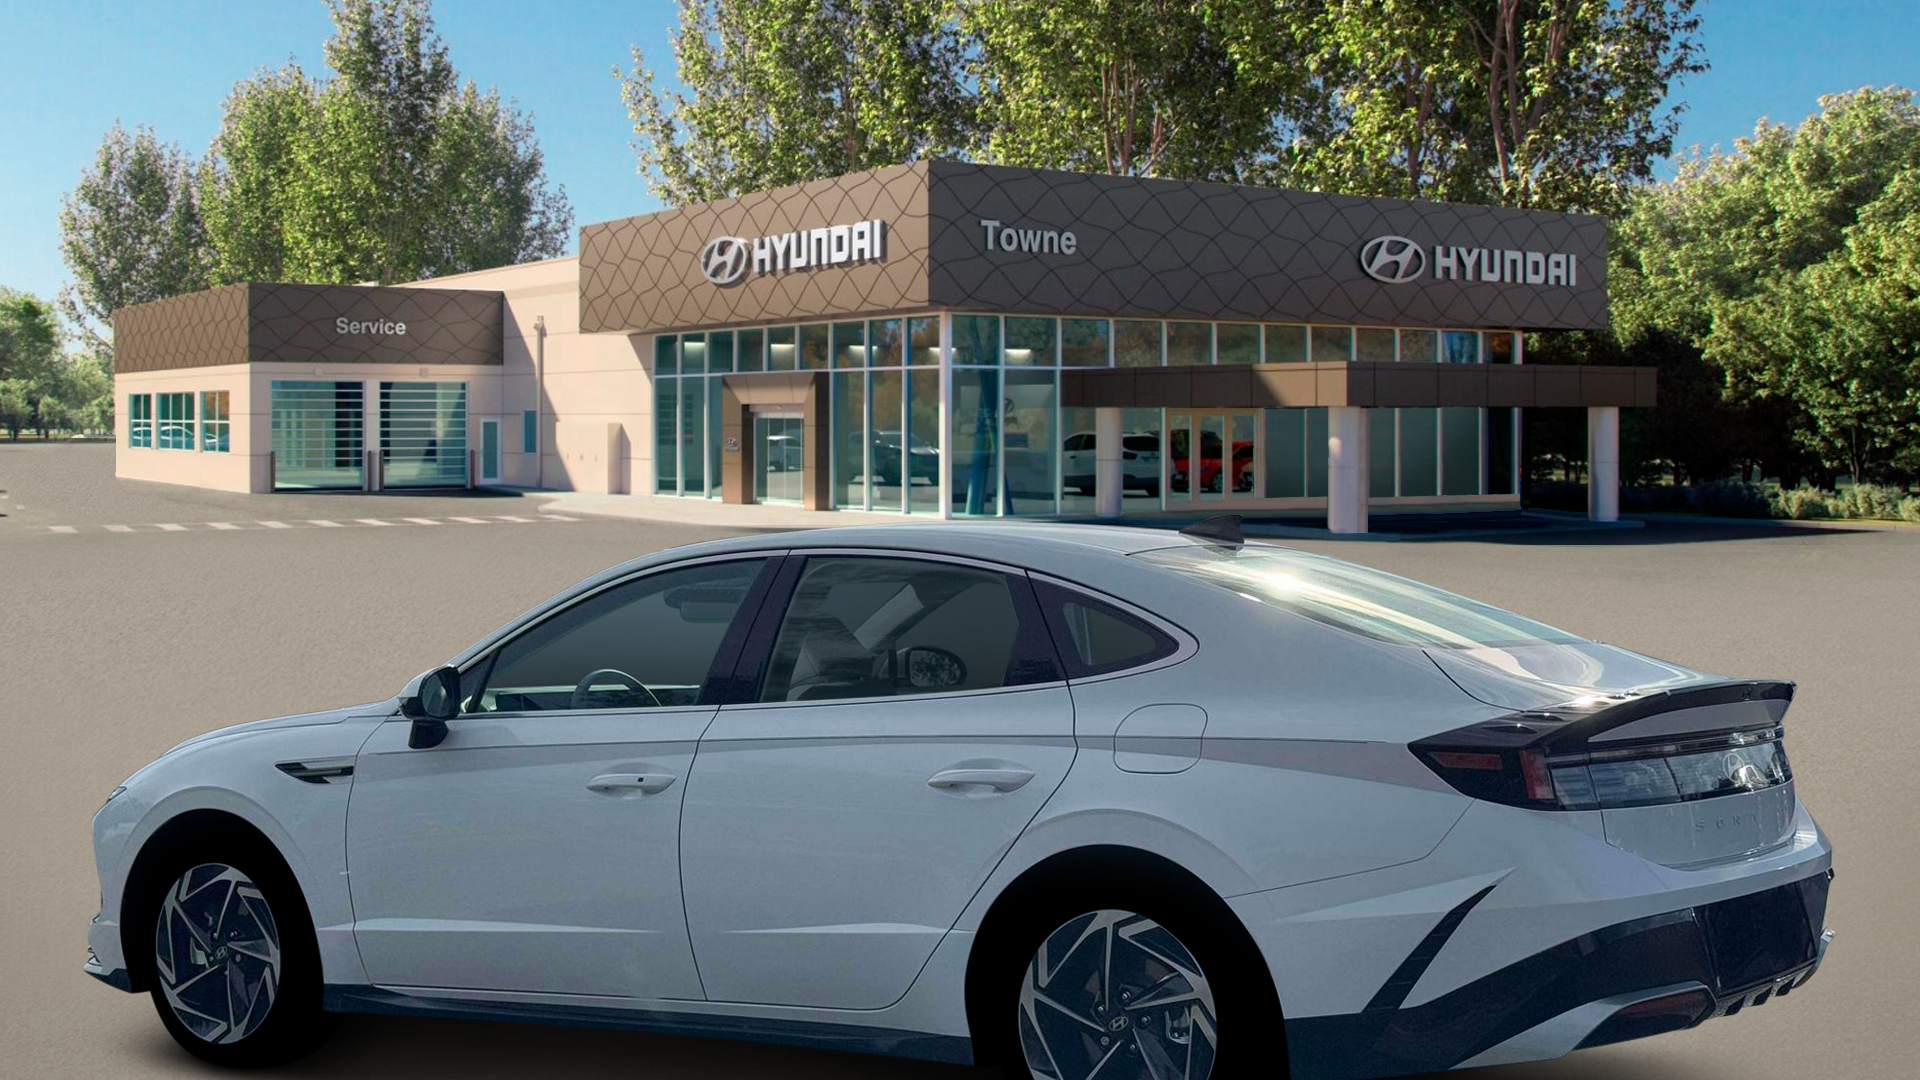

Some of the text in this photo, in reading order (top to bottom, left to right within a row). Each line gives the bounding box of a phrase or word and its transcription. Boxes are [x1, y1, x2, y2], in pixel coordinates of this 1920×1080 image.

[753, 219, 881, 273] HYUNDAI
[981, 220, 1077, 255] Towne
[1435, 245, 1577, 286] HYUNDAI
[336, 317, 406, 335] Service
